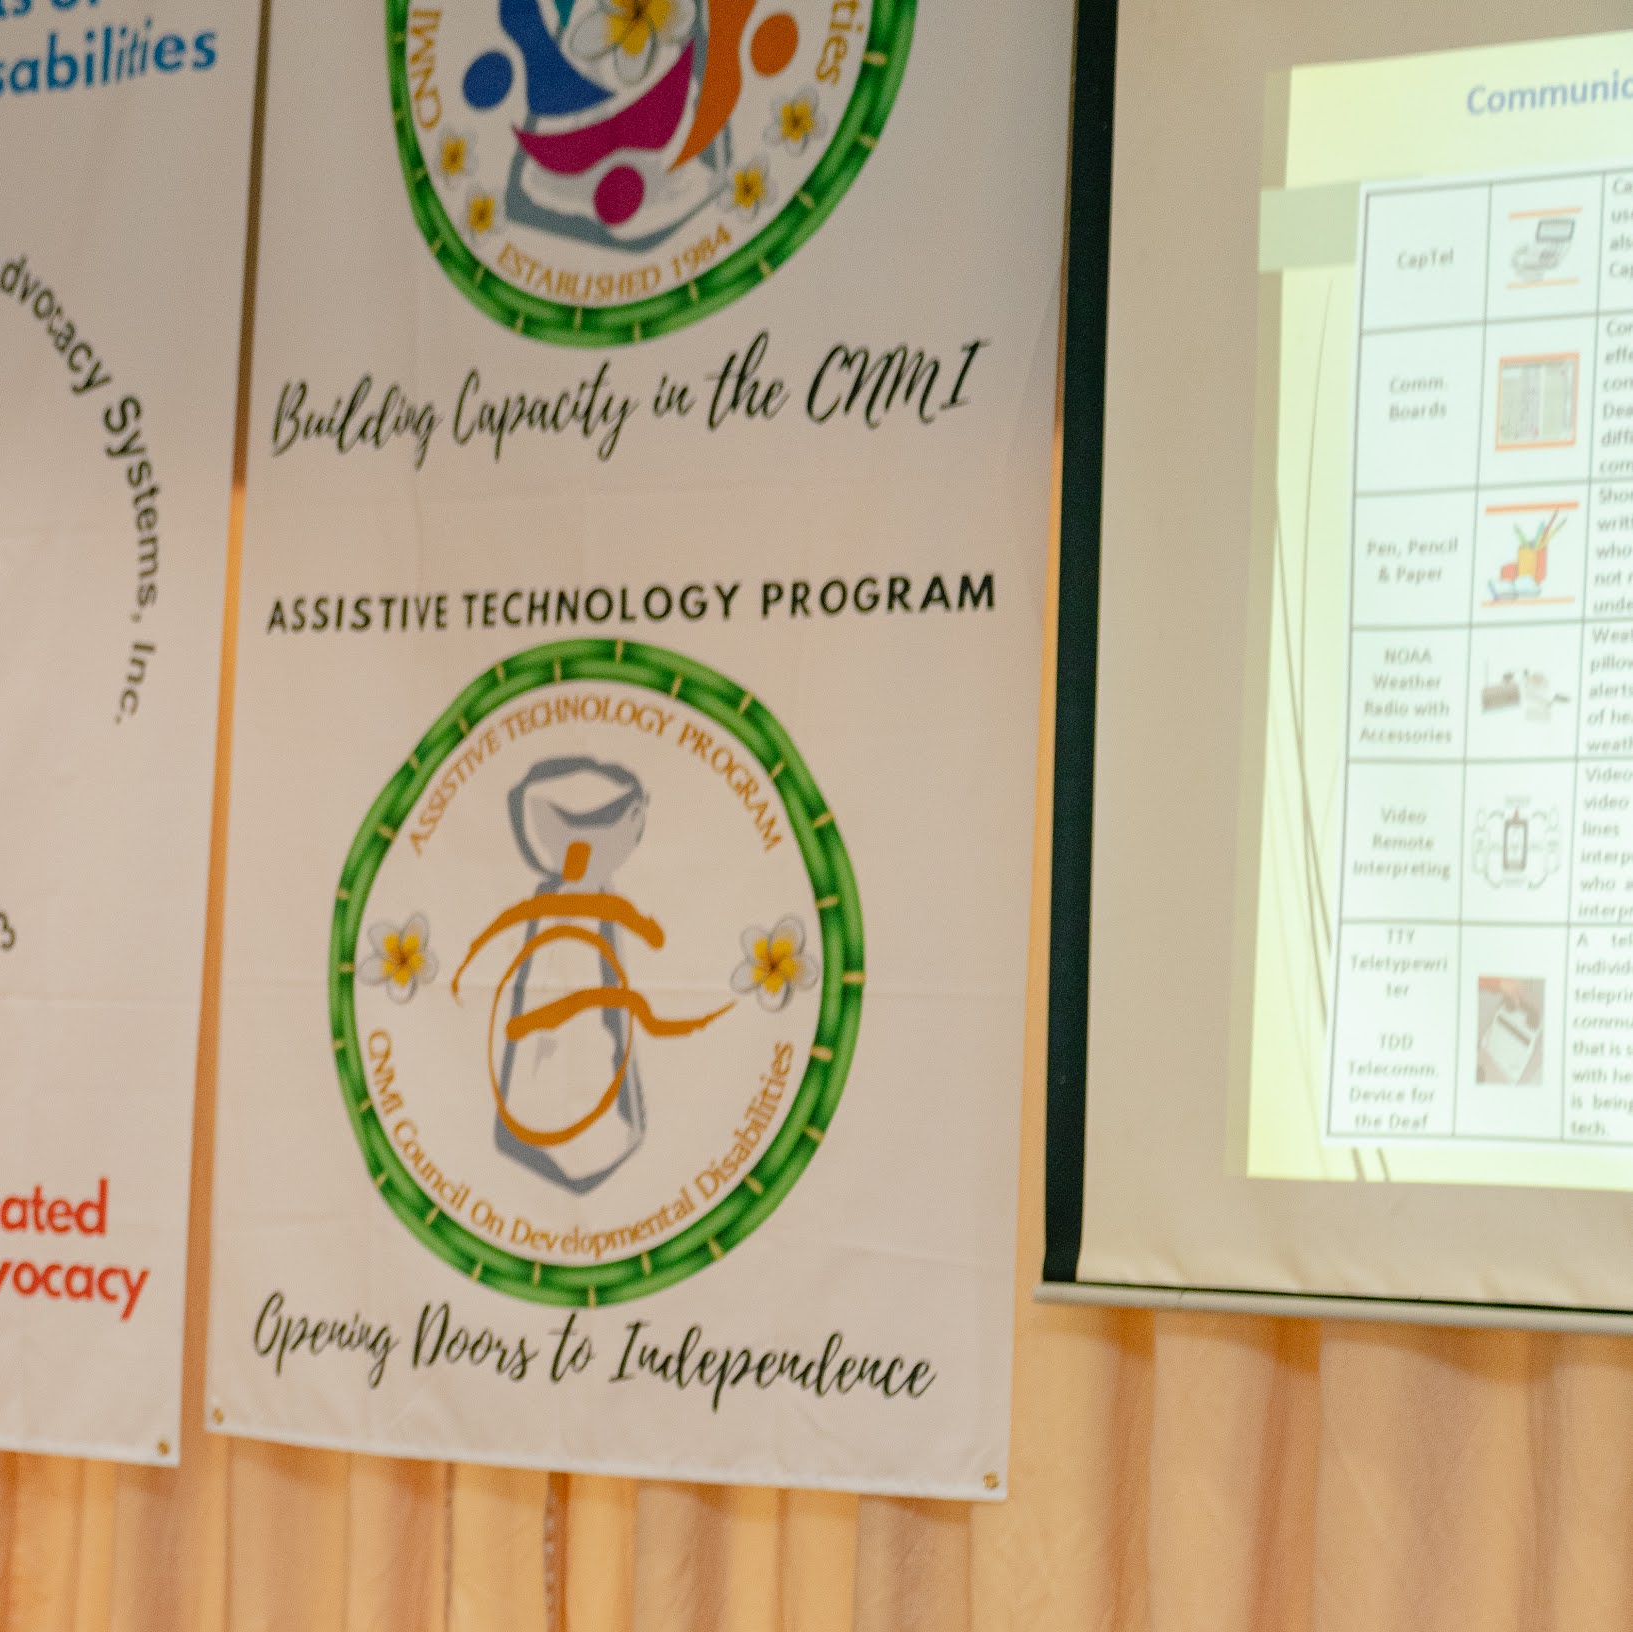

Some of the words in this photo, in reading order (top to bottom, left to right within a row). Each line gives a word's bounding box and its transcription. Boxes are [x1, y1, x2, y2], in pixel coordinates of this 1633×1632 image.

[269, 372, 444, 471] Building
[452, 359, 640, 463] Capacity
[651, 362, 696, 422] in
[704, 330, 790, 431] the
[805, 337, 992, 430] CNMI
[266, 592, 451, 635] ASSISTIVE
[460, 584, 742, 630] TECHNOLOGY
[760, 572, 999, 622] PROGRAM
[406, 726, 503, 857] ASSISTIVE
[498, 694, 677, 742] TECHNOLOGY
[677, 720, 784, 853] PROGRAM
[366, 1028, 405, 1117] CNMI
[392, 1115, 467, 1215] Council
[468, 1195, 507, 1238] On
[509, 1187, 696, 1258] Developmental
[692, 1039, 794, 1199] Disabilities
[251, 1290, 398, 1389] Opening
[411, 1300, 539, 1383] Doors
[545, 1311, 596, 1383] to
[609, 1319, 939, 1414] Independence
